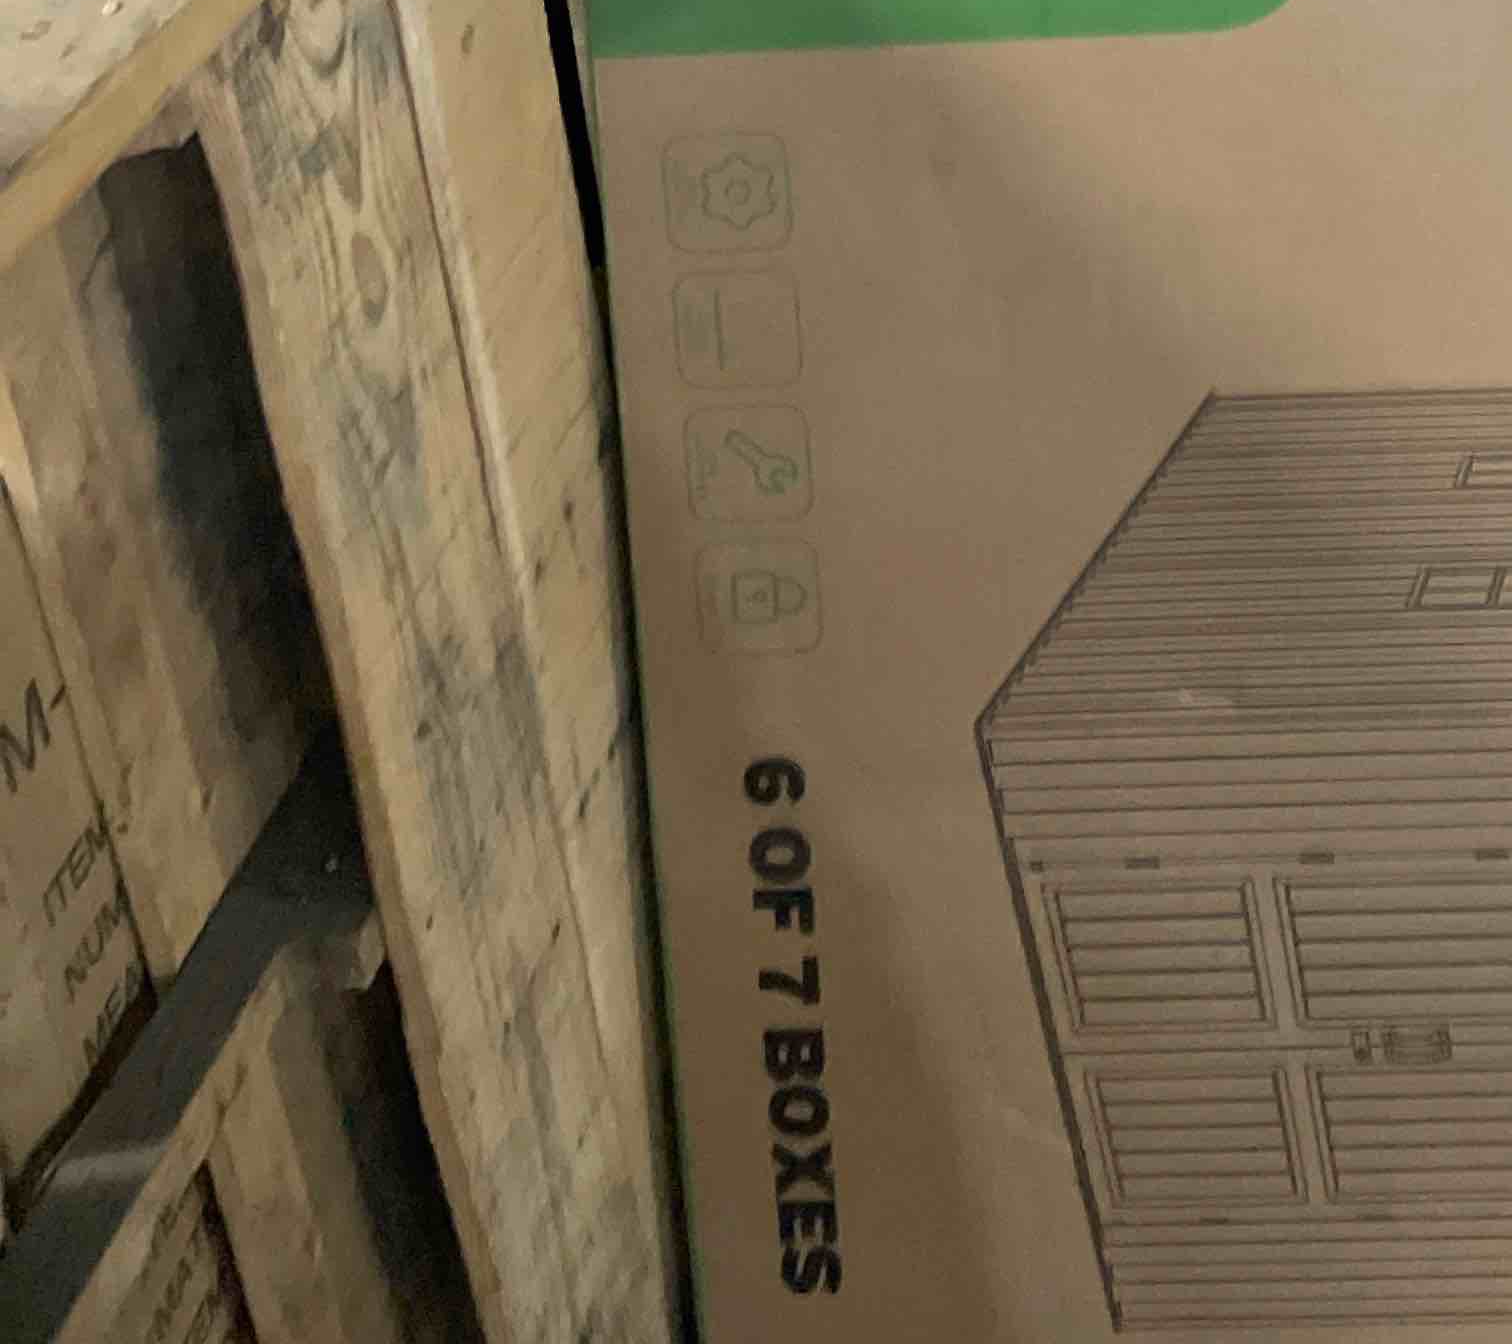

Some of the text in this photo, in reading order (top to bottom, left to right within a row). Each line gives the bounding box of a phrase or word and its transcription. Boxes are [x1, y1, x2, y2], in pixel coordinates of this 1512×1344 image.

[743, 757, 842, 1295] 6 OF 7 BOXES
